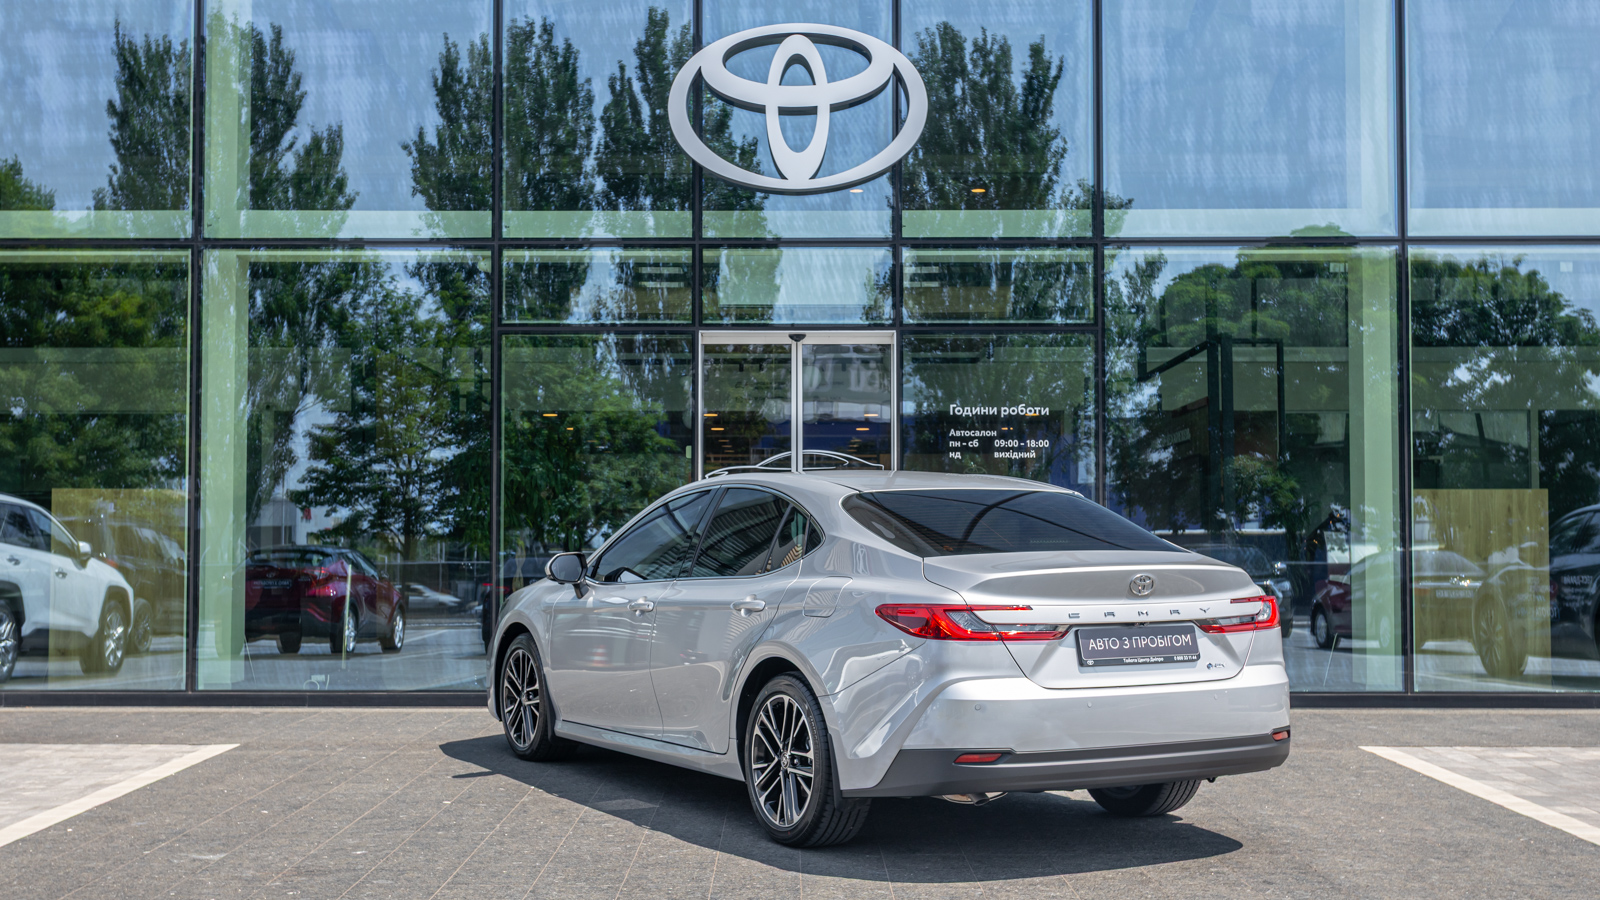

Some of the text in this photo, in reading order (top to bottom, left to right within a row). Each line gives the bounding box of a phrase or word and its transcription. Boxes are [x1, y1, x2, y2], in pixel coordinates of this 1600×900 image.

[949, 404, 1050, 418] Години роботи
[949, 428, 997, 437] Автосалон
[968, 439, 979, 447] сб
[994, 439, 1019, 447] 09:00
[1026, 439, 1050, 447] 18:00
[949, 450, 1036, 459] нд вихідний
[1068, 607, 1210, 619] CAMRY
[1088, 637, 1120, 651] АВТО
[1132, 634, 1192, 648] ПРОБІГОМ
